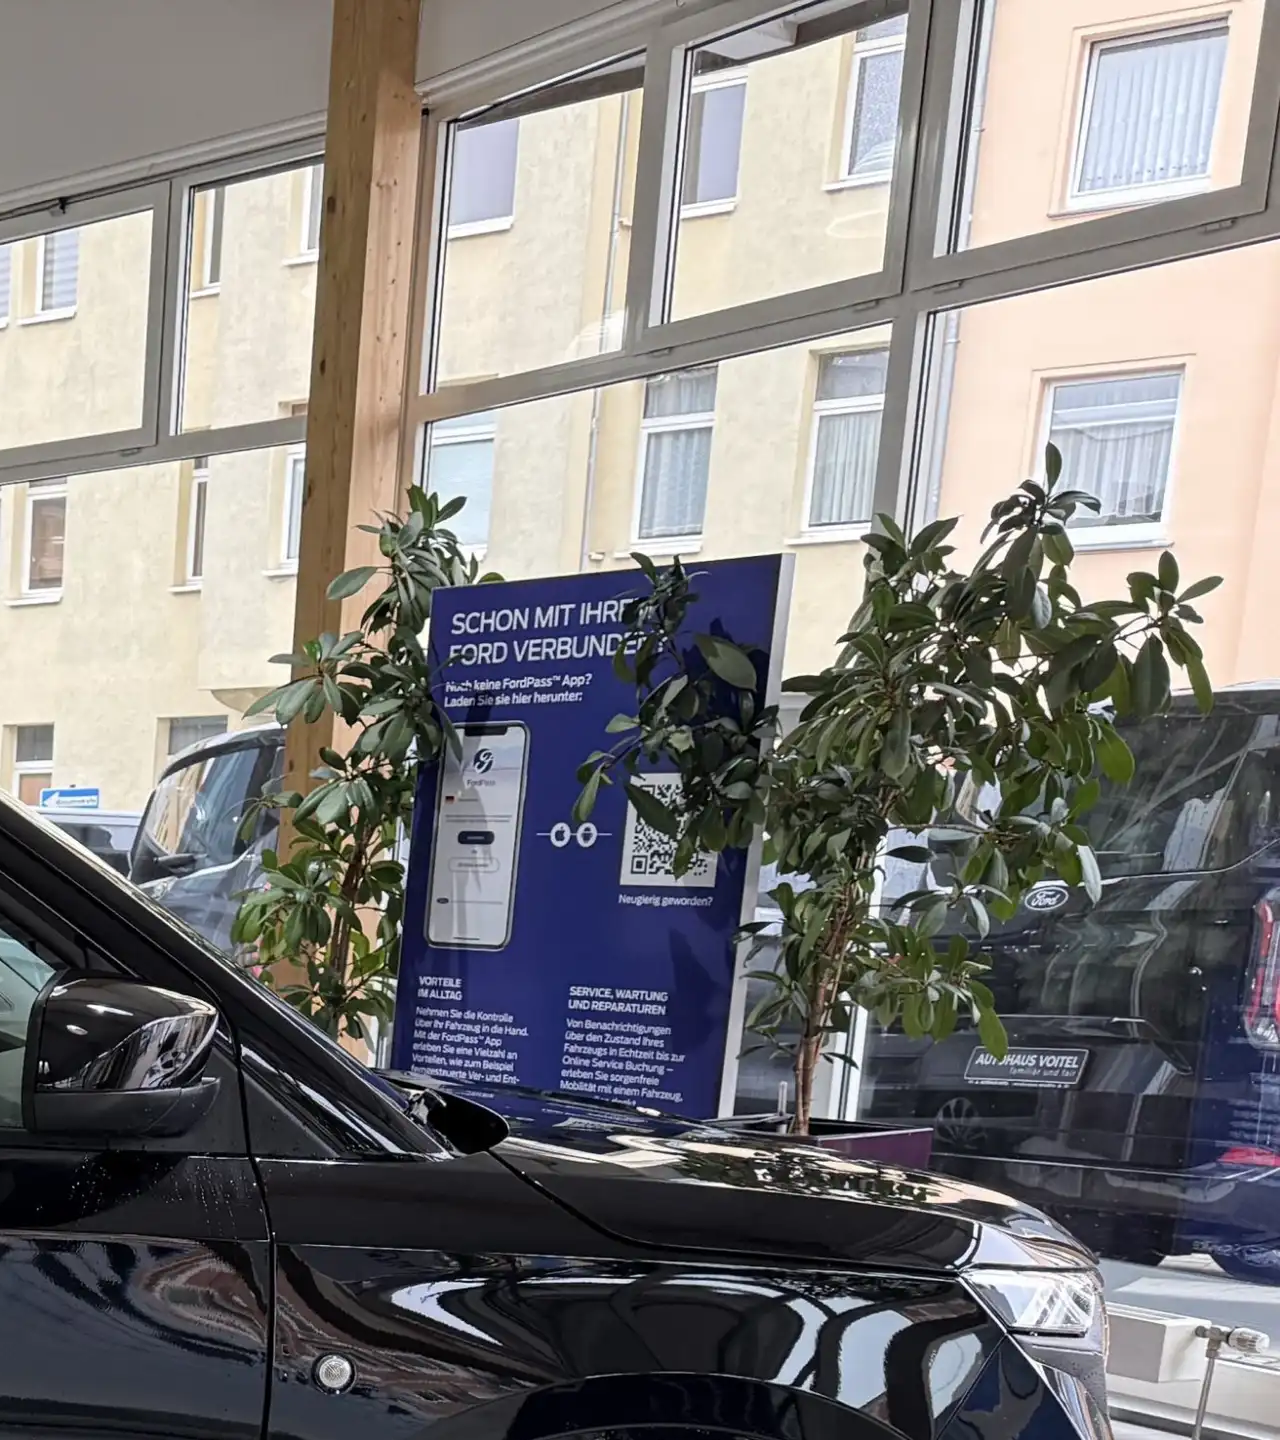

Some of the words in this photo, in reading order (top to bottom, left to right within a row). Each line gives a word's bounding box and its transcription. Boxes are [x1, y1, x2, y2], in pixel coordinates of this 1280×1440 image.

[451, 607, 530, 636] SCHON
[534, 603, 576, 629] MIT
[448, 640, 507, 667] FORD
[474, 679, 500, 690] keine
[562, 673, 592, 688] App?
[444, 696, 475, 707] Laden
[477, 694, 493, 706] Sie
[495, 694, 510, 706] sie
[512, 692, 532, 704] hier
[534, 691, 583, 703] herunter:
[618, 894, 661, 906] Neugierig
[662, 895, 713, 906] geworden?
[419, 976, 462, 988] VORTEILE
[418, 988, 429, 998] IM
[429, 989, 462, 1000] ALLTAG
[569, 986, 614, 999] SERVICE,
[615, 988, 668, 1002] WARTUNG
[416, 1007, 449, 1018] Nehmen
[449, 1009, 463, 1019] Sie
[463, 1010, 476, 1020] die
[477, 1011, 514, 1022] Kontrolle
[568, 999, 590, 1010] UND
[591, 1000, 666, 1015] REPARATUREN
[444, 1020, 481, 1034] Fahrzeug
[482, 1023, 490, 1033] in
[491, 1024, 503, 1034] die
[504, 1025, 529, 1037] Hand.
[566, 1018, 583, 1029] Von
[584, 1019, 671, 1037] Benachrichtigungen
[427, 1031, 440, 1040] der
[484, 1036, 502, 1047] App
[565, 1030, 585, 1041] über
[586, 1032, 602, 1042] den
[604, 1033, 641, 1046] Zustand
[642, 1036, 664, 1048] Ihres
[413, 1042, 441, 1052] erleben
[442, 1044, 455, 1054] Sie
[456, 1046, 473, 1056] eine
[474, 1047, 506, 1060] Vielzahl
[506, 1051, 518, 1061] an
[564, 1043, 608, 1057] Fahrzeugs
[609, 1047, 617, 1056] in
[618, 1047, 654, 1060] Echtzeit
[655, 1051, 670, 1061] bis
[670, 1053, 686, 1062] zur
[449, 1057, 463, 1067] wie
[464, 1060, 481, 1068] zum
[482, 1060, 514, 1072] Beispiel
[562, 1055, 590, 1067] Online
[591, 1058, 624, 1070] Service
[625, 1061, 665, 1075] Buchung
[1039, 1055, 1079, 1068] VOITEL
[485, 1074, 502, 1083] und
[561, 1068, 593, 1079] erleben
[595, 1070, 608, 1081] Sie
[609, 1073, 660, 1086] sorgenfreie
[560, 1079, 596, 1093] Mobilität
[597, 1084, 612, 1095] mit
[613, 1085, 640, 1097] einem
[640, 1087, 683, 1103] Fahrzeug,
